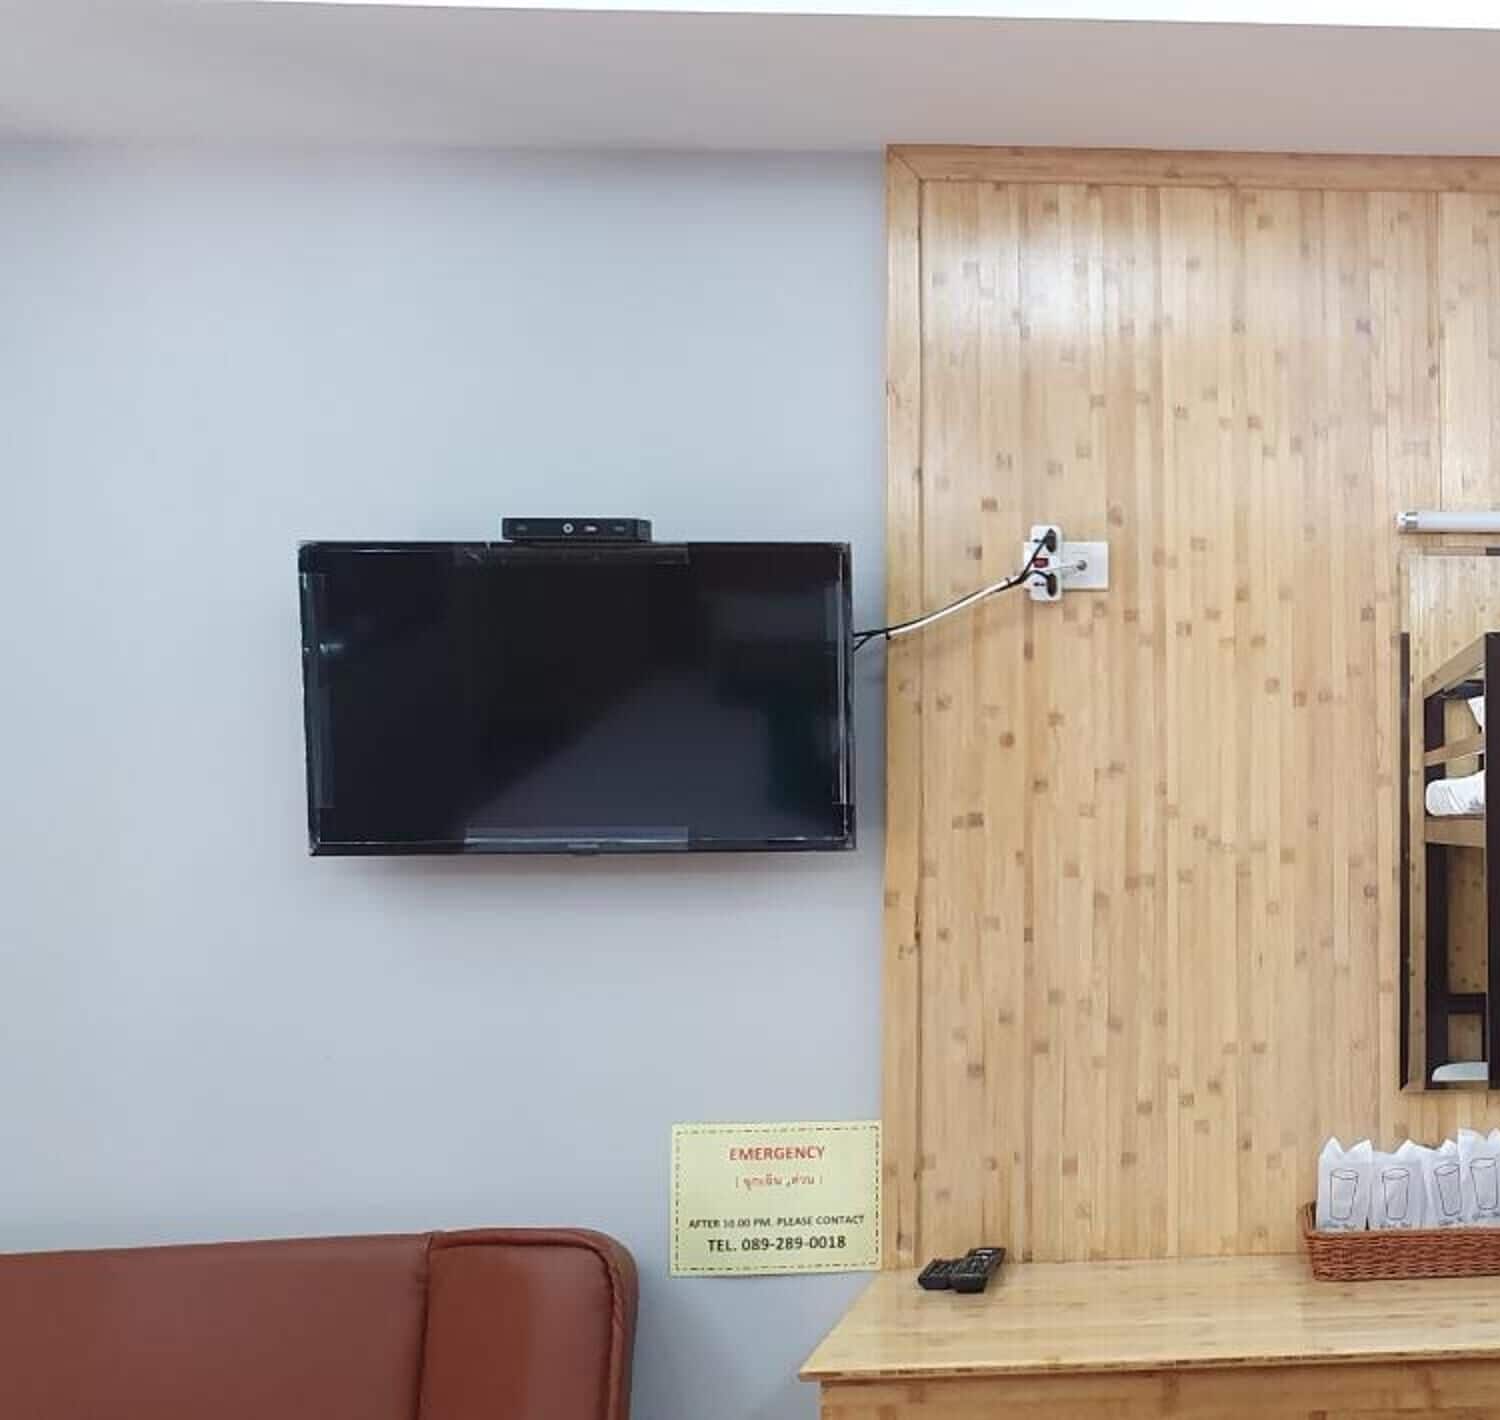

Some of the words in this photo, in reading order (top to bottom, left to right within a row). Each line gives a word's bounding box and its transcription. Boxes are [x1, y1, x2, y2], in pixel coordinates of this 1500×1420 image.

[729, 1145, 825, 1161] EMERGENCY
[688, 1218, 721, 1230] AFTER
[776, 1216, 814, 1228] PLEASE
[815, 1214, 865, 1225] CONTACT
[707, 1238, 737, 1253] TEL.
[741, 1235, 847, 1251] 089-289-0018
